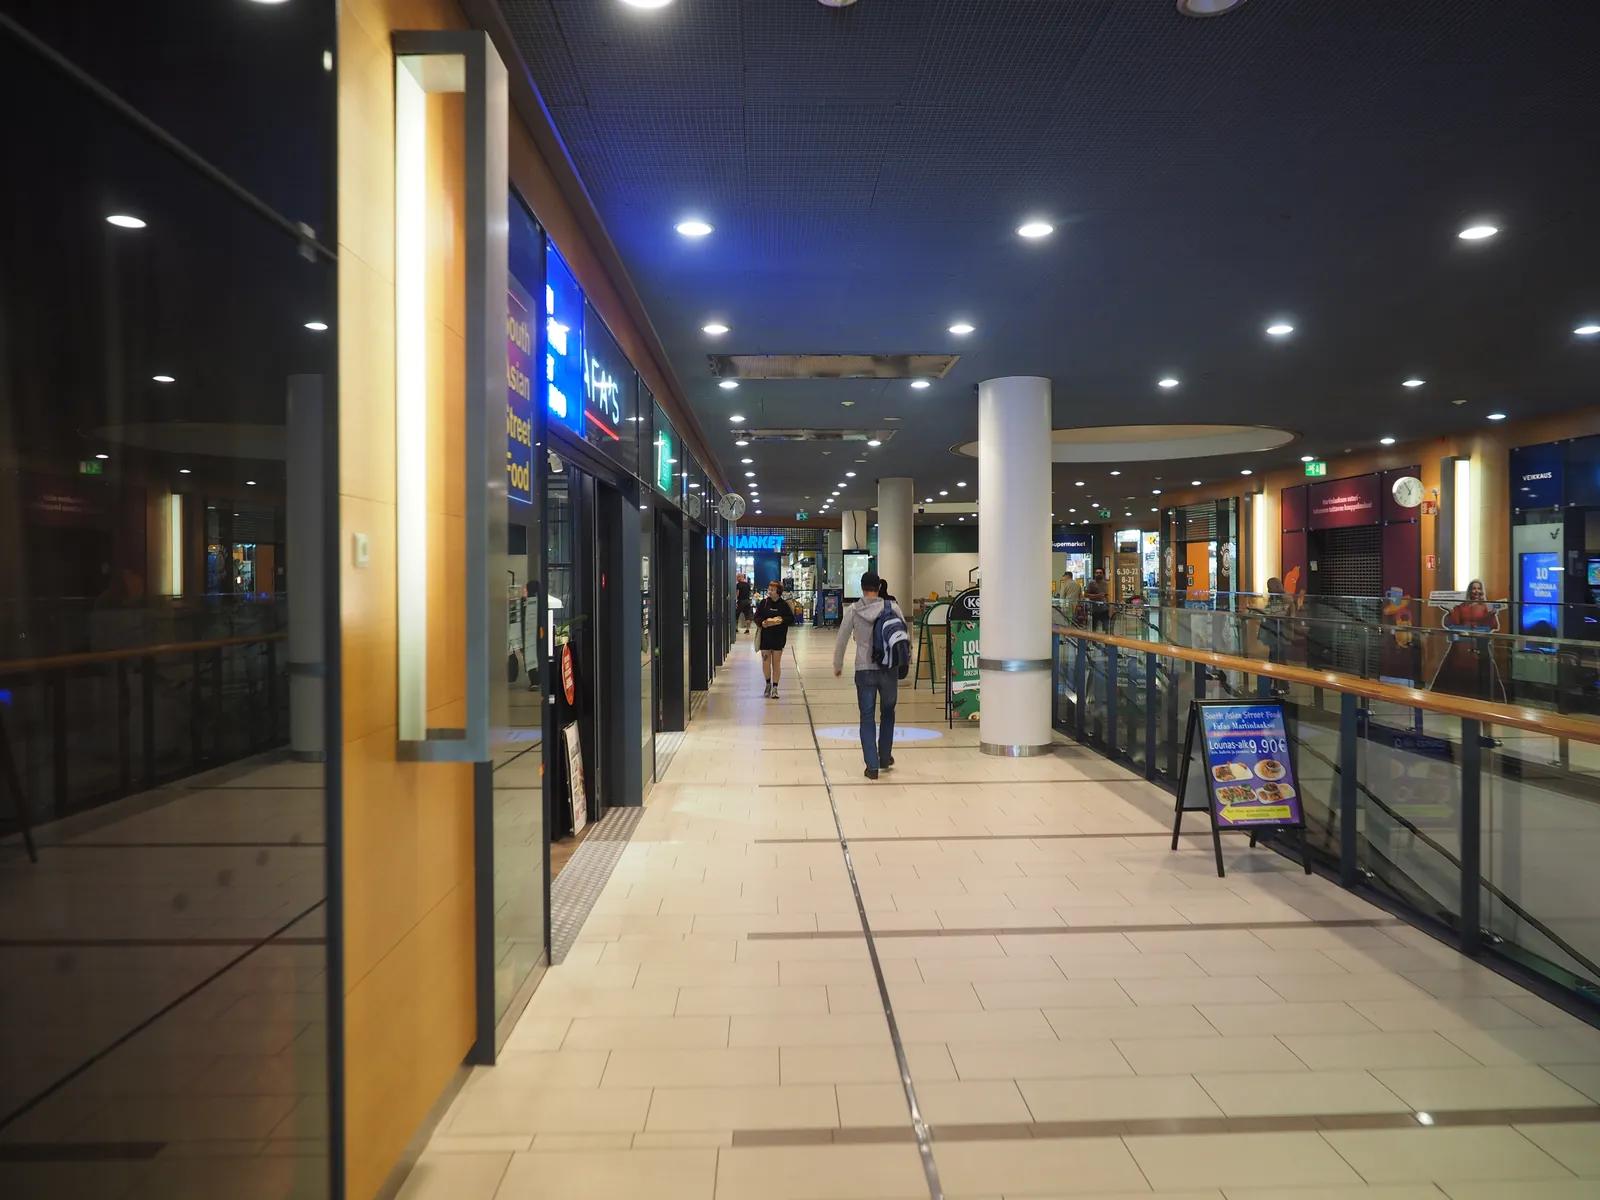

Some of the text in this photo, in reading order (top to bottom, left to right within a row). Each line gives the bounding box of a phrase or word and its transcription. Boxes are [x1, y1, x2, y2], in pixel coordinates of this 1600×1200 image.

[1523, 472, 1552, 481] VEIKKAUS
[1116, 568, 1139, 576] 6.30-22
[1536, 567, 1548, 580] 10
[1204, 712, 1223, 720] South
[1243, 711, 1264, 719] Street
[1249, 739, 1287, 754] 9.90€
